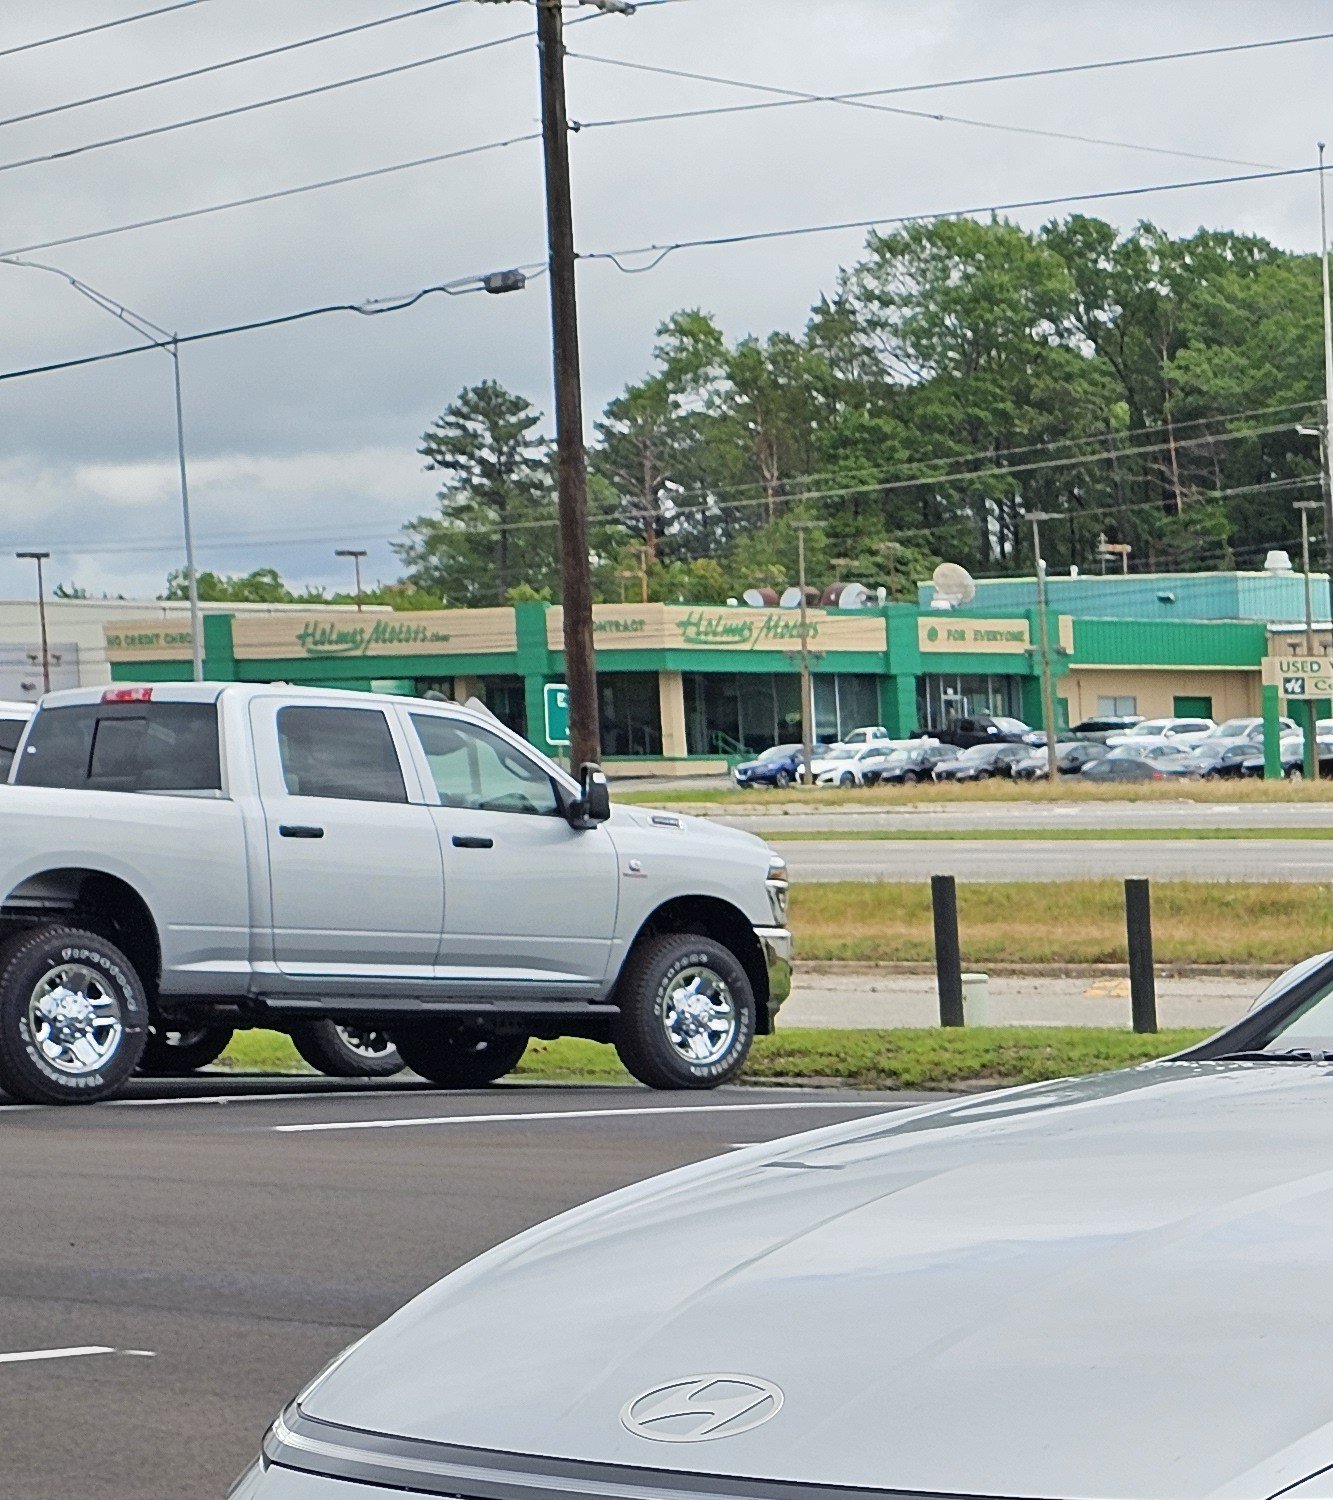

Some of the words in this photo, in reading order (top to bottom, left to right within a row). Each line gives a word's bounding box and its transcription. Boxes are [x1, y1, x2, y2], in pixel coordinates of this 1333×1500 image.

[676, 610, 755, 645] Holmes
[163, 632, 193, 645] CHEC
[295, 619, 366, 655] Holmes
[947, 629, 967, 642] FOR
[973, 629, 1025, 642] EVERYONE
[1280, 660, 1321, 674] USED
